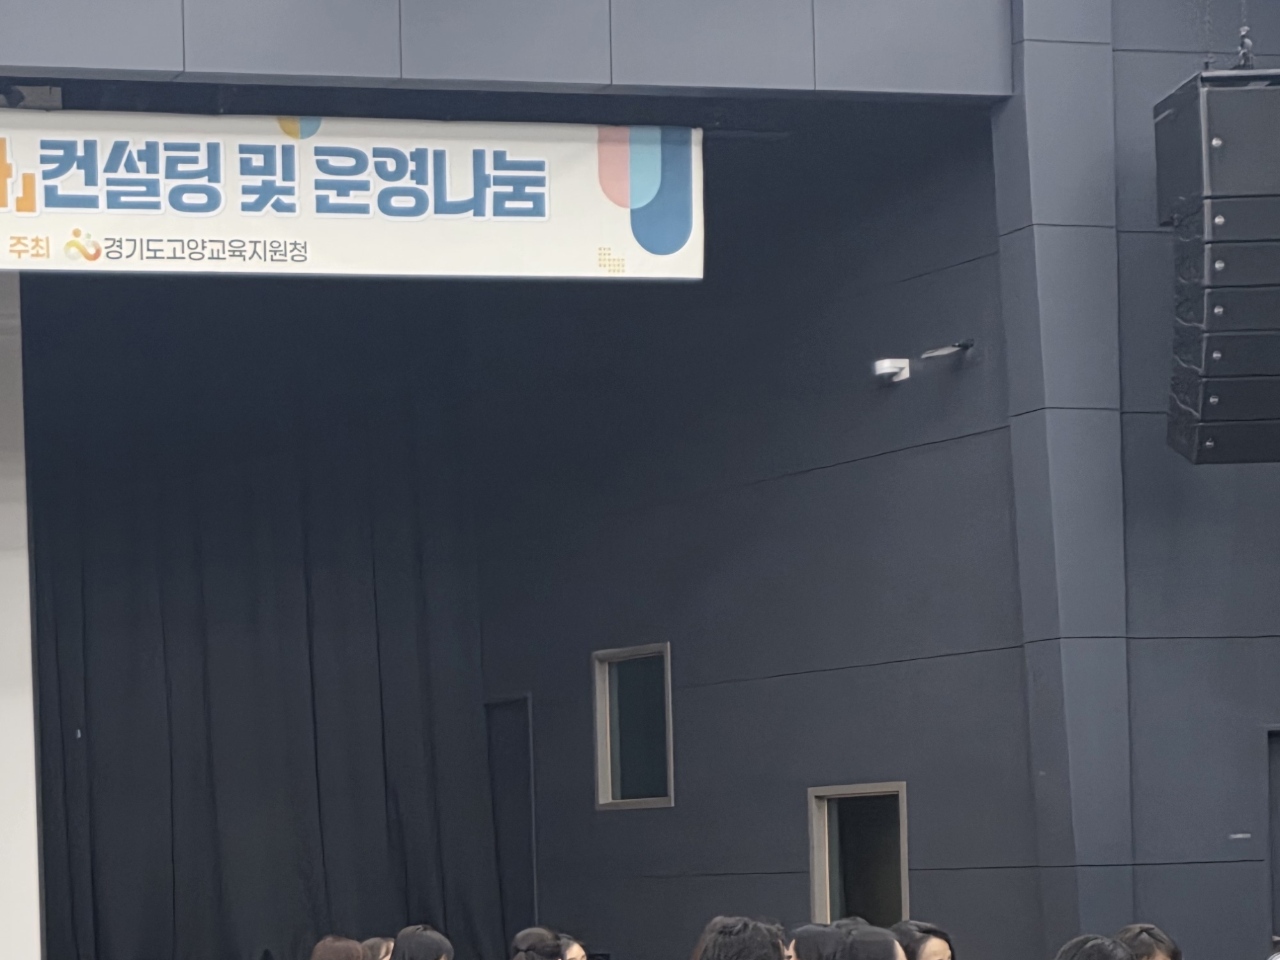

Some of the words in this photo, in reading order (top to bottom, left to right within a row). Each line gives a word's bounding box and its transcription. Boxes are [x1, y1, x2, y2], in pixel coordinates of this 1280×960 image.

[238, 143, 297, 214] 및
[314, 146, 546, 218] 운영나눔
[9, 235, 51, 260] 주최
[103, 237, 308, 263] 경기도고양교육지원청
